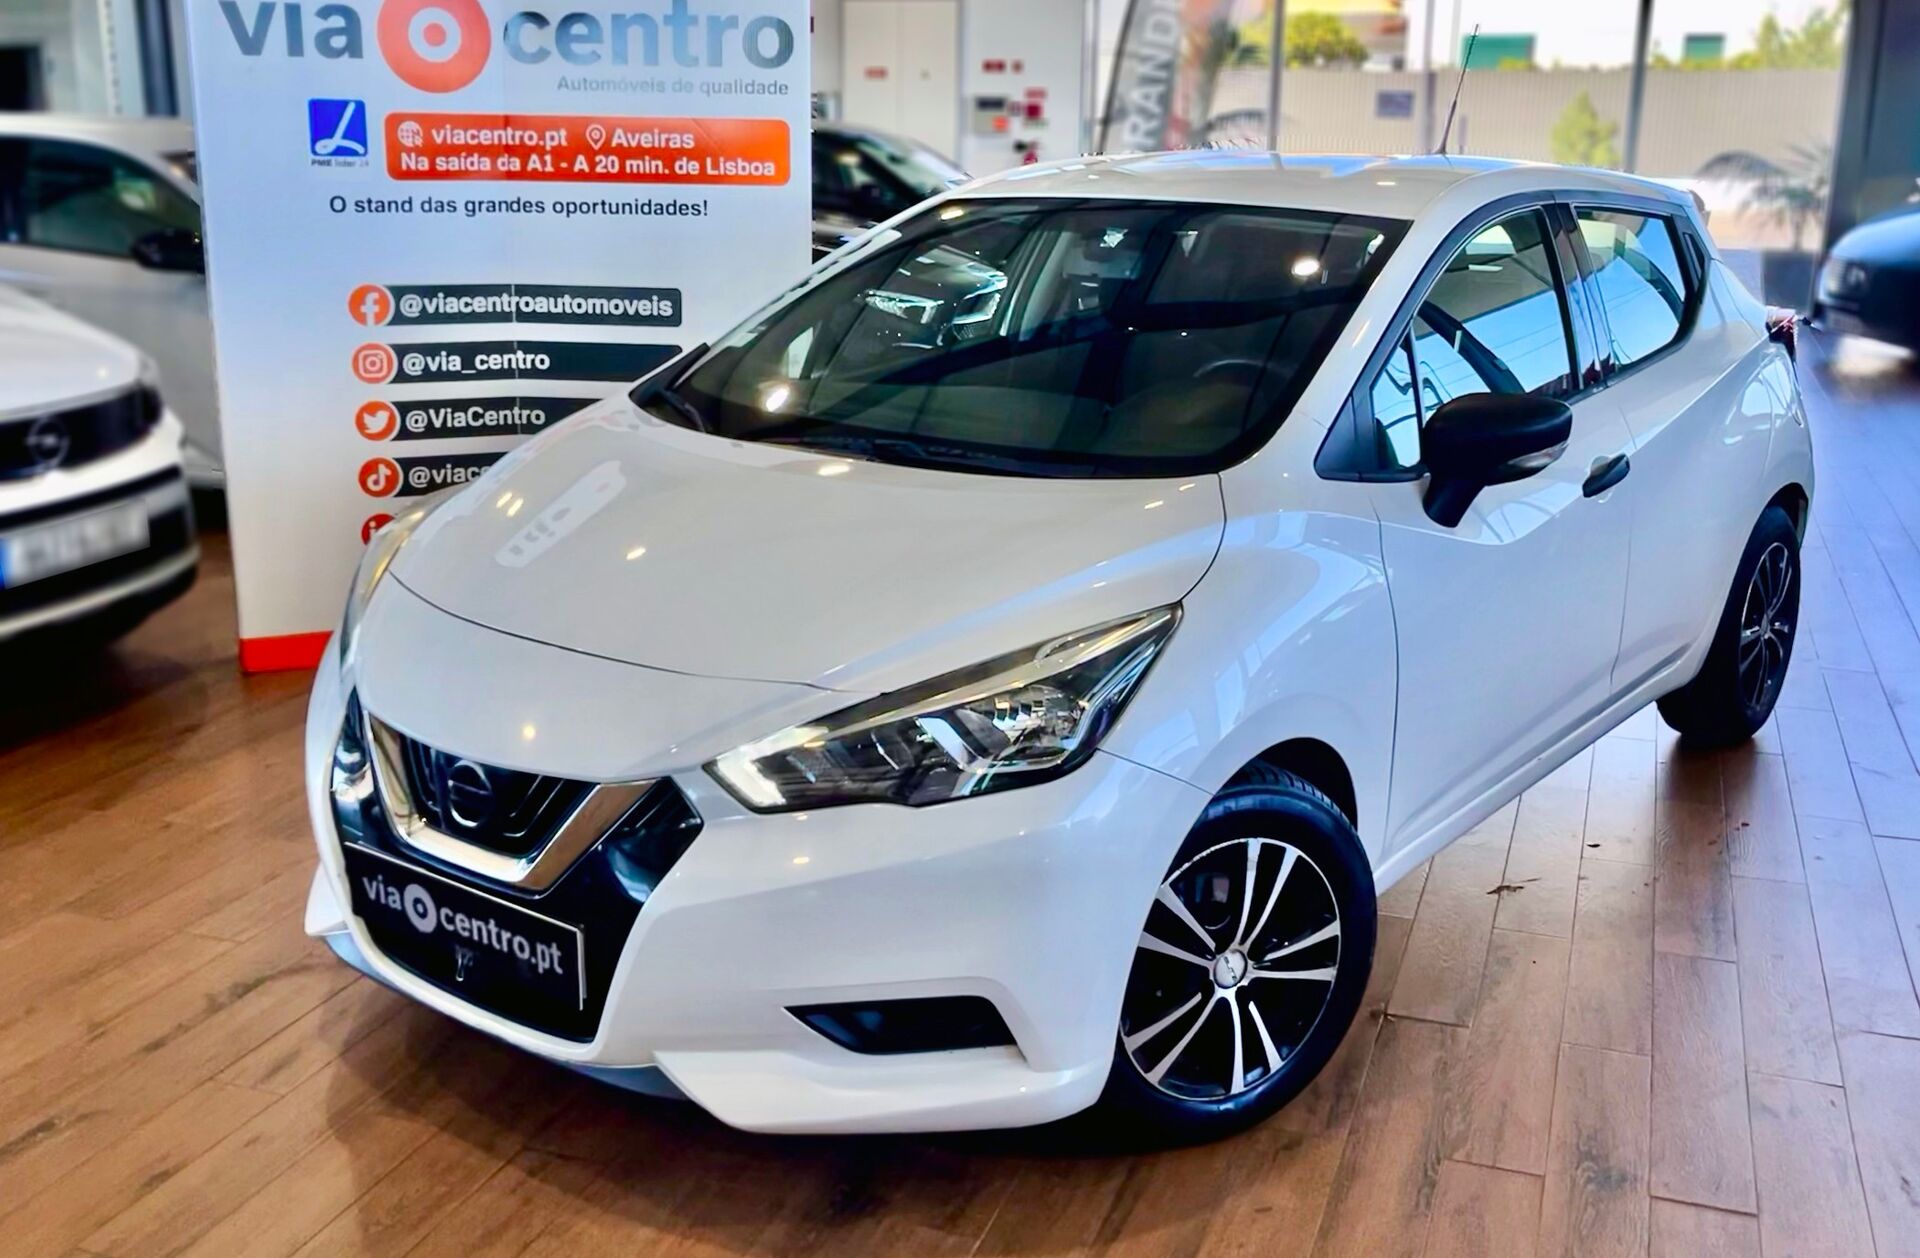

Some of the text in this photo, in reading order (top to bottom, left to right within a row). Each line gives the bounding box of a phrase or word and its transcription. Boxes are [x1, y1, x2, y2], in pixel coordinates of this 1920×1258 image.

[218, 0, 794, 69] via centro
[557, 76, 789, 98] Automóveis de qualidade
[1121, 0, 1180, 152] RAND
[431, 124, 695, 151] viacentro.pt Aveiras
[400, 152, 430, 172] Na
[435, 151, 491, 172] saída
[496, 153, 521, 172] da
[527, 154, 554, 173] A1
[573, 154, 590, 173] A
[594, 155, 619, 174] 20
[625, 155, 670, 175] min.
[674, 158, 700, 175] de
[706, 156, 776, 177] Lisboa
[329, 195, 708, 219] O stand das grandes oportunidades!
[400, 292, 674, 318] @viacentroautomoveis
[402, 350, 551, 376] @via_centro
[405, 406, 546, 433] @ViaCentro
[362, 873, 564, 975] via centro.pt
